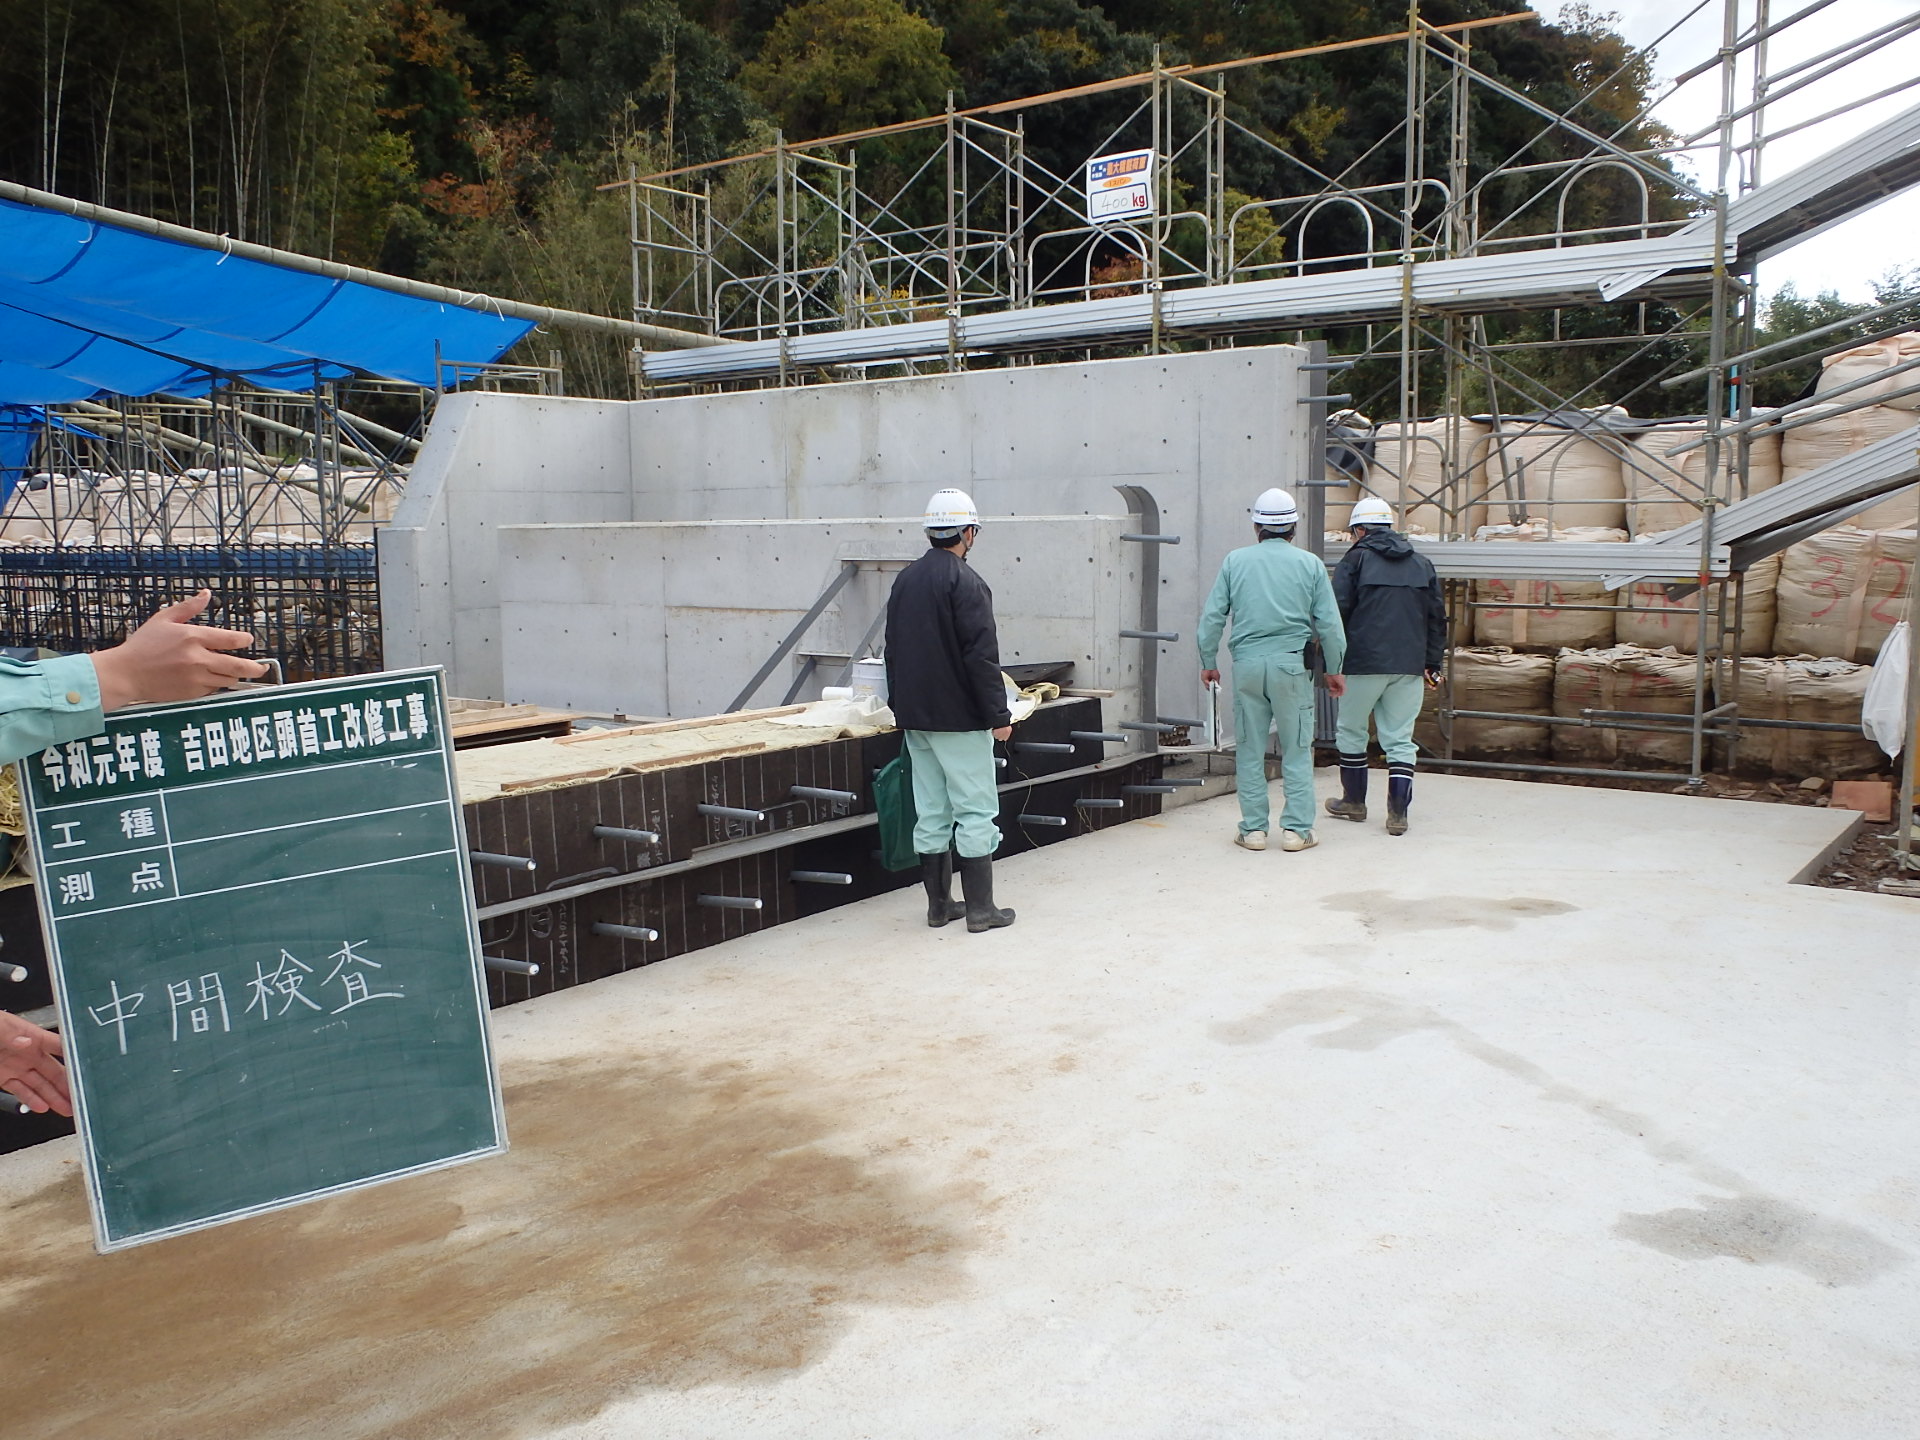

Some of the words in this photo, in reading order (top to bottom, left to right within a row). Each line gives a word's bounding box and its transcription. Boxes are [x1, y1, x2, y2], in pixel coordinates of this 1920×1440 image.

[1101, 193, 1128, 211] 400
[1132, 192, 1145, 207] kg
[42, 728, 166, 793] 令和元年度
[180, 692, 430, 774] 吉田地区頭首工改修工事
[87, 938, 406, 1056] 中間検査
